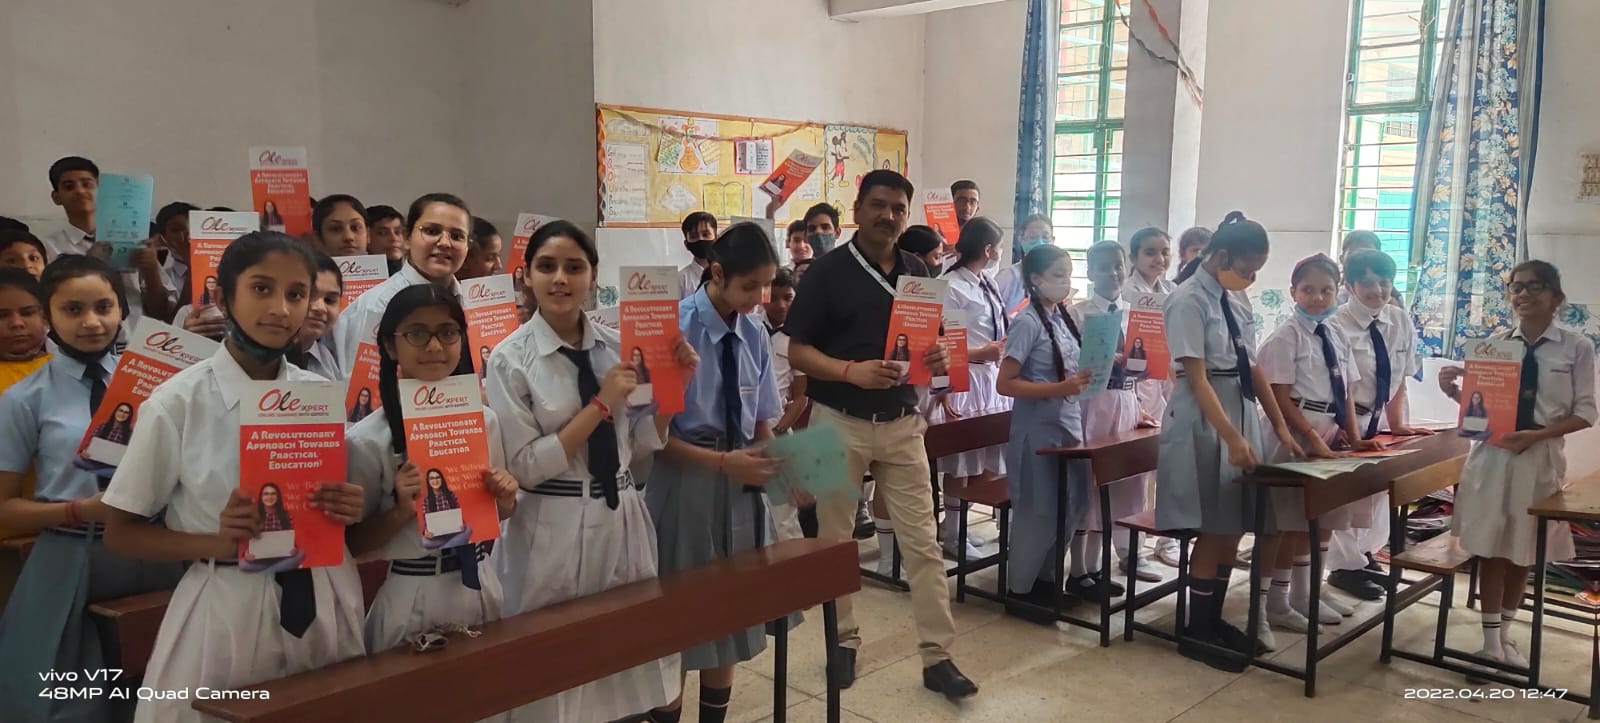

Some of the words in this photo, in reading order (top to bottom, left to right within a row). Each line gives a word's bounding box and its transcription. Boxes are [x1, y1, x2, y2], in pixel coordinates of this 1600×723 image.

[524, 218, 541, 231] Ol
[627, 272, 651, 290] Ole
[468, 283, 491, 300] Ole
[145, 332, 184, 354] Ole
[128, 358, 136, 366] A
[136, 360, 174, 378] REVOLUT
[258, 388, 301, 411] Ole
[414, 384, 446, 406] Ole
[411, 423, 419, 432] A
[419, 418, 478, 431] REVOLUTIONARY
[251, 431, 259, 440] A
[261, 430, 336, 440] REVOLUTIONARY
[410, 431, 448, 441] APPROACH
[448, 427, 483, 437] TOWARDS
[246, 441, 296, 451] APPROACH
[298, 439, 341, 449] TOWARDS
[428, 437, 468, 448] PRACTICAL
[269, 450, 319, 461] PRACTICAL
